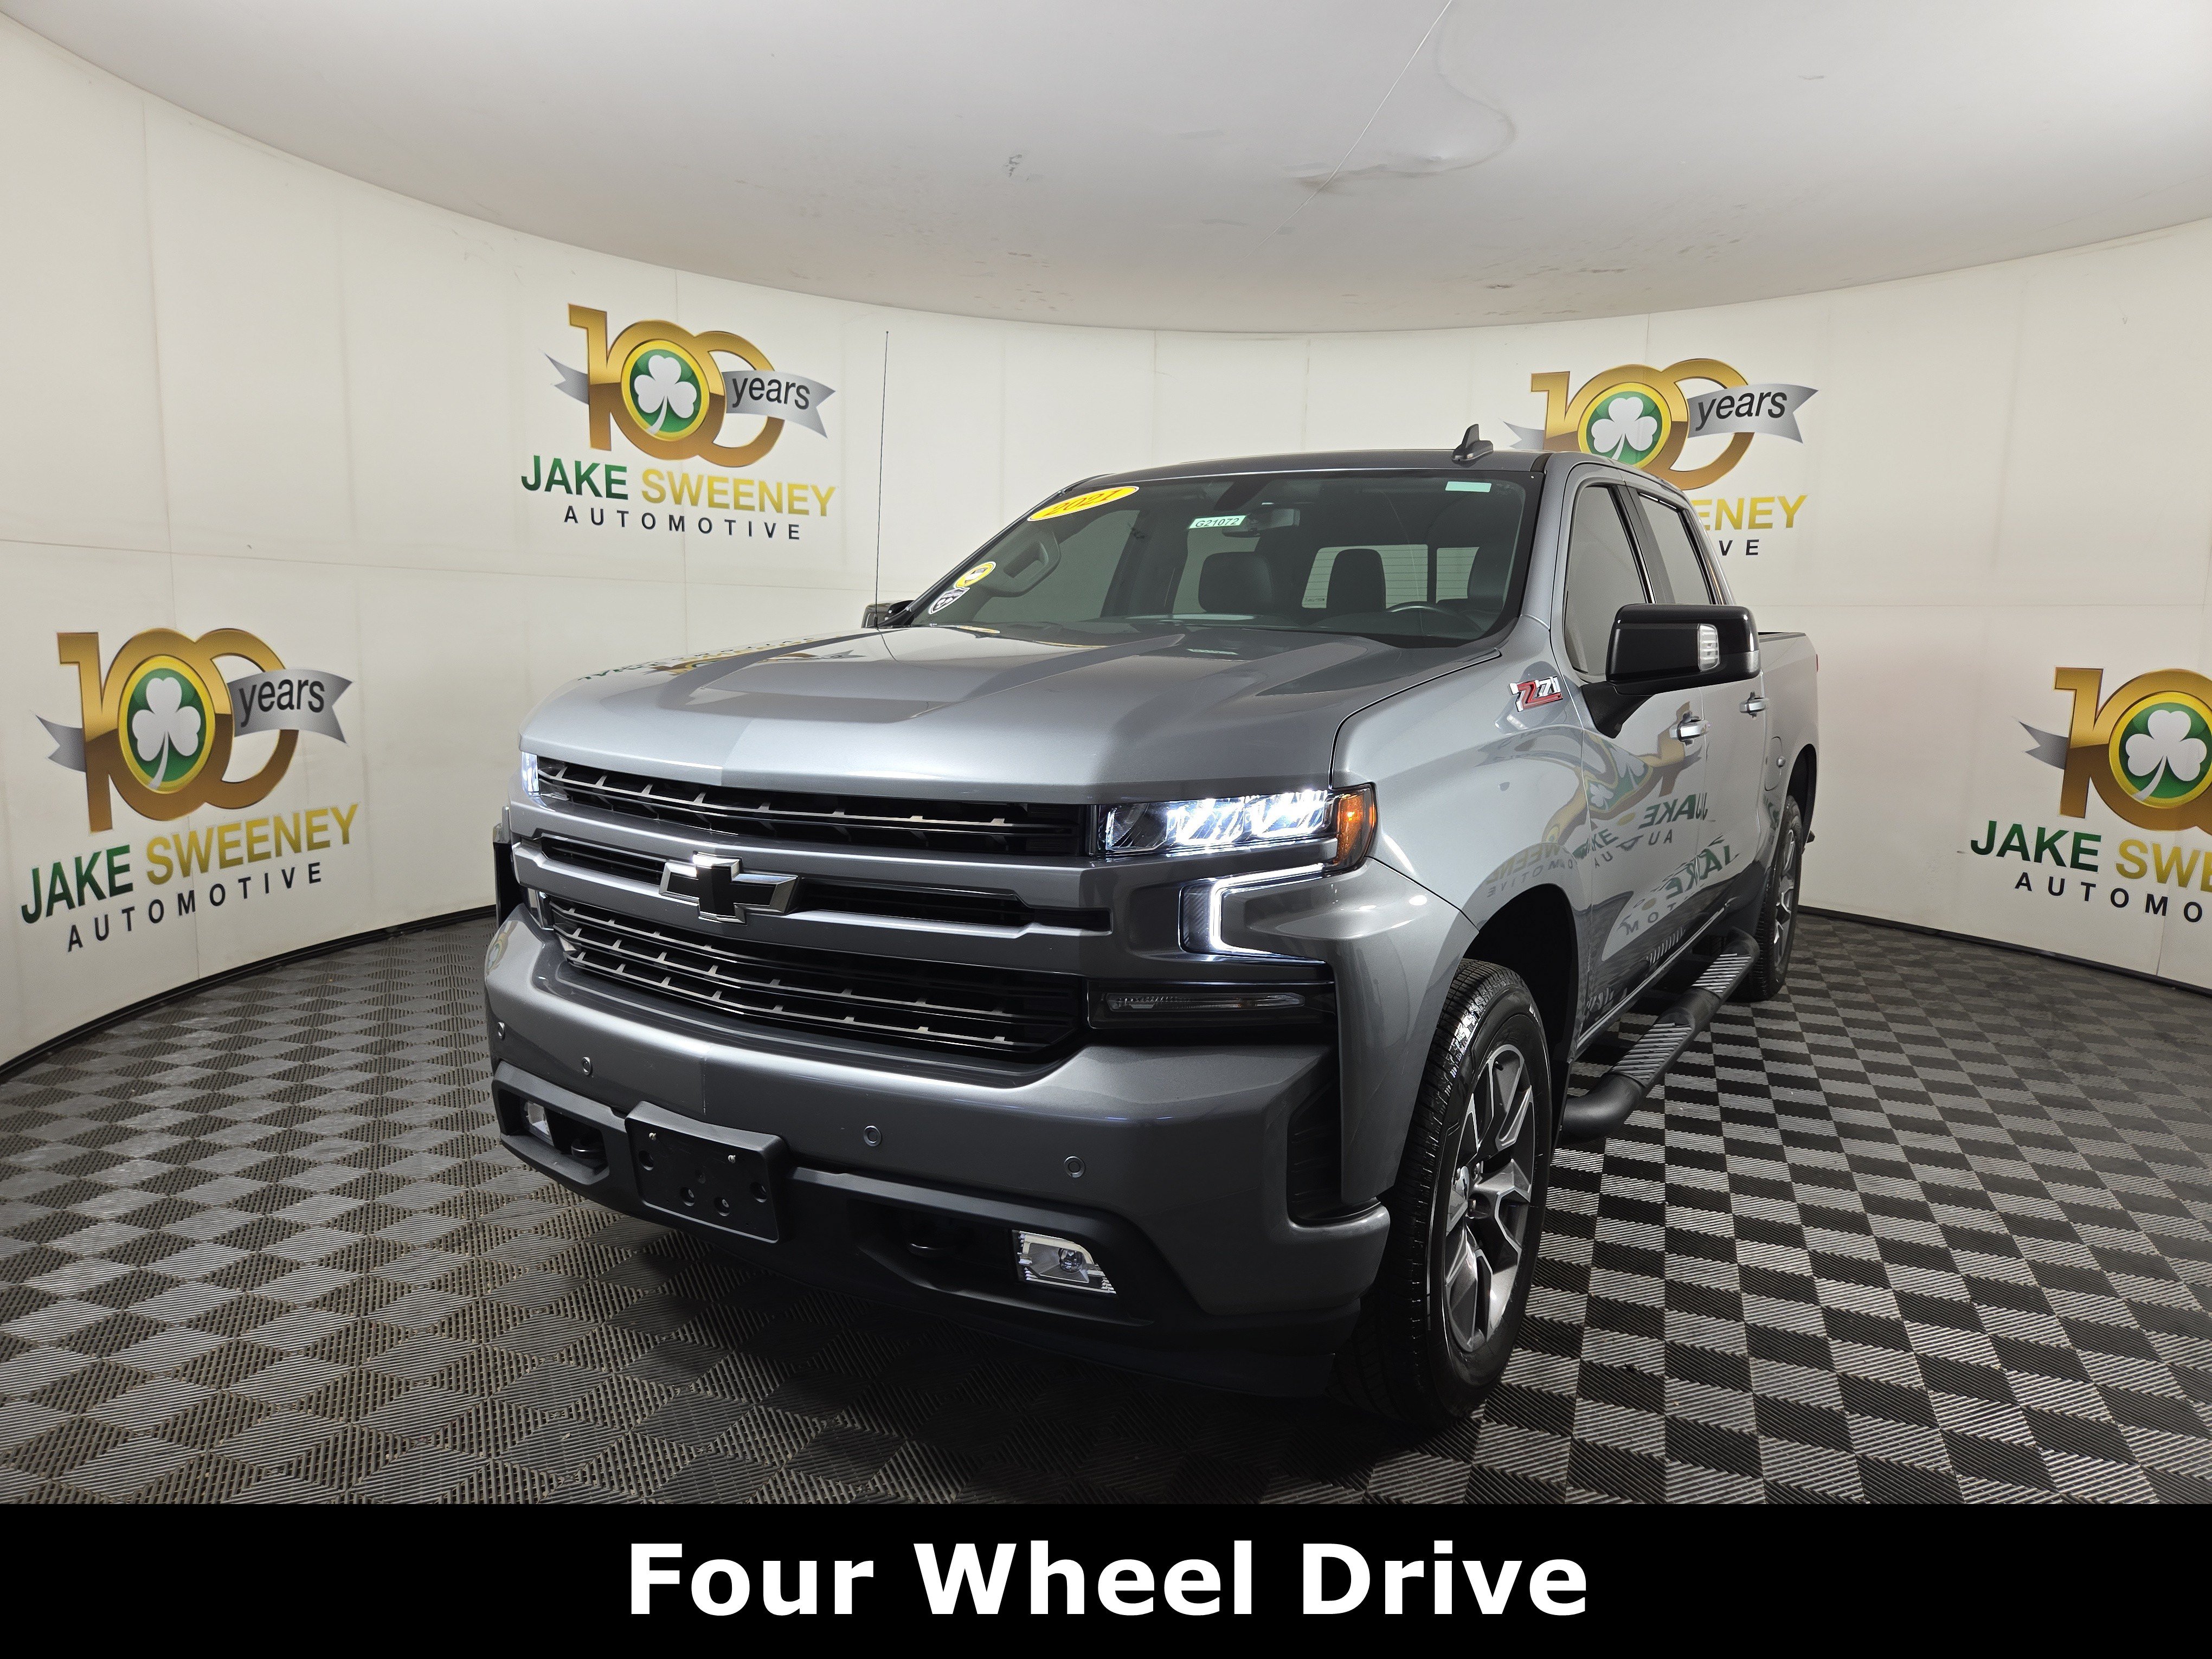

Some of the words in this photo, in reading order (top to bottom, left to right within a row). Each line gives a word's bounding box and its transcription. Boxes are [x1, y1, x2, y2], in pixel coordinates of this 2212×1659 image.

[568, 303, 785, 468] 100
[732, 375, 810, 409] years
[1695, 390, 1787, 432] years
[520, 455, 628, 500] JAKE
[641, 468, 836, 517] SWEENEY
[1043, 489, 1123, 517] 2021
[564, 505, 800, 541] AUTOMOTIVE
[1195, 518, 1239, 527] G21072
[1690, 494, 1808, 531] ENEY
[1509, 676, 1563, 712] Z71
[56, 628, 300, 833] 100
[239, 679, 325, 728] years
[2054, 666, 2212, 837] 10
[21, 844, 134, 924] JAKE
[146, 803, 359, 886] SWEENEY
[1970, 820, 2102, 872] JAKE
[68, 862, 321, 953] AUTOMOTIVE
